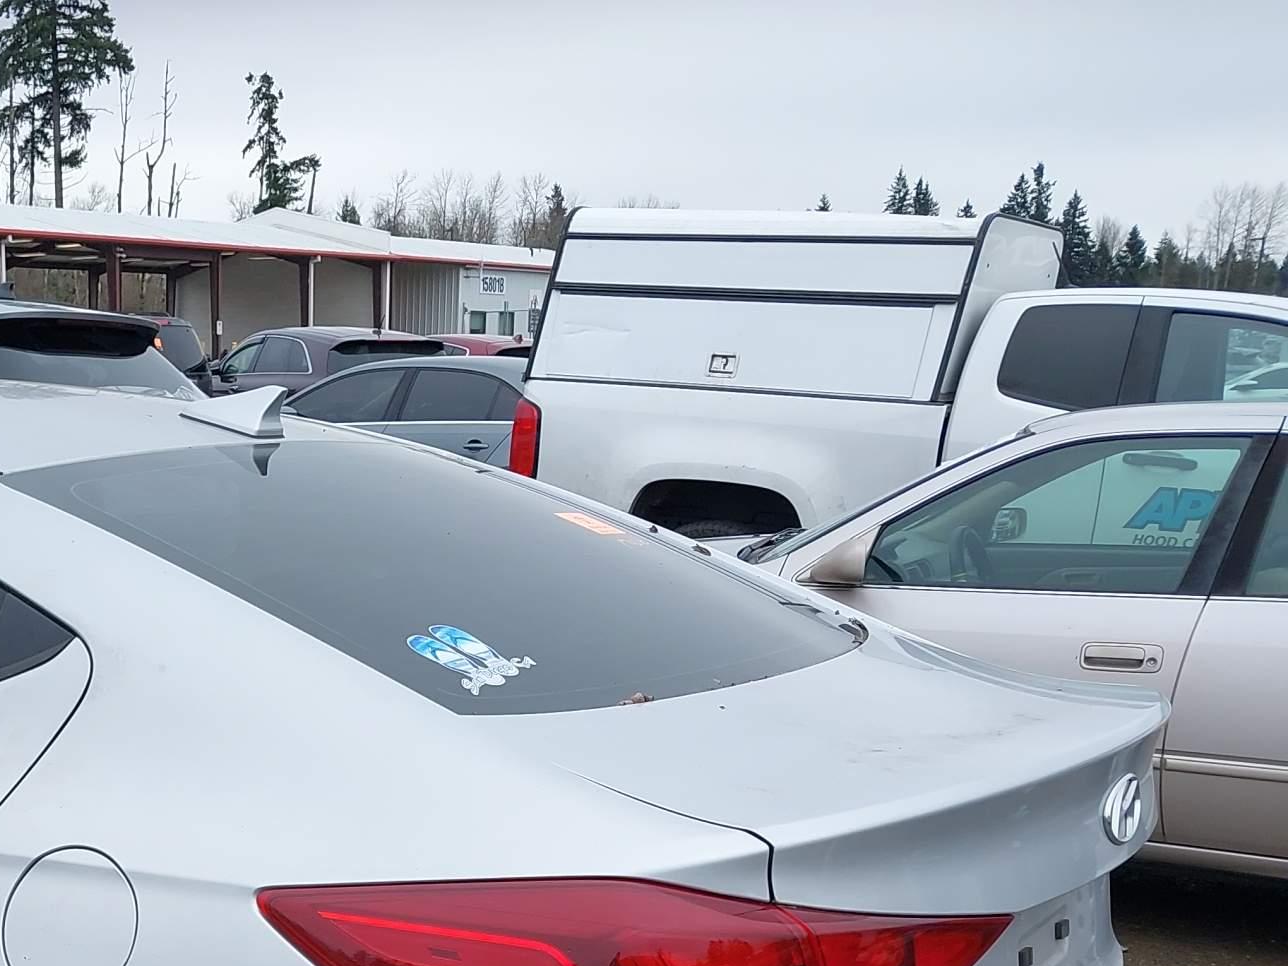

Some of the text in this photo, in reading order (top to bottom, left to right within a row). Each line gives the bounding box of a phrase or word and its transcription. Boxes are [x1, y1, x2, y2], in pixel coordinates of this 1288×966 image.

[481, 276, 505, 293] 15801B
[1123, 486, 1223, 532] AP
[1132, 534, 1178, 548] HOOD
